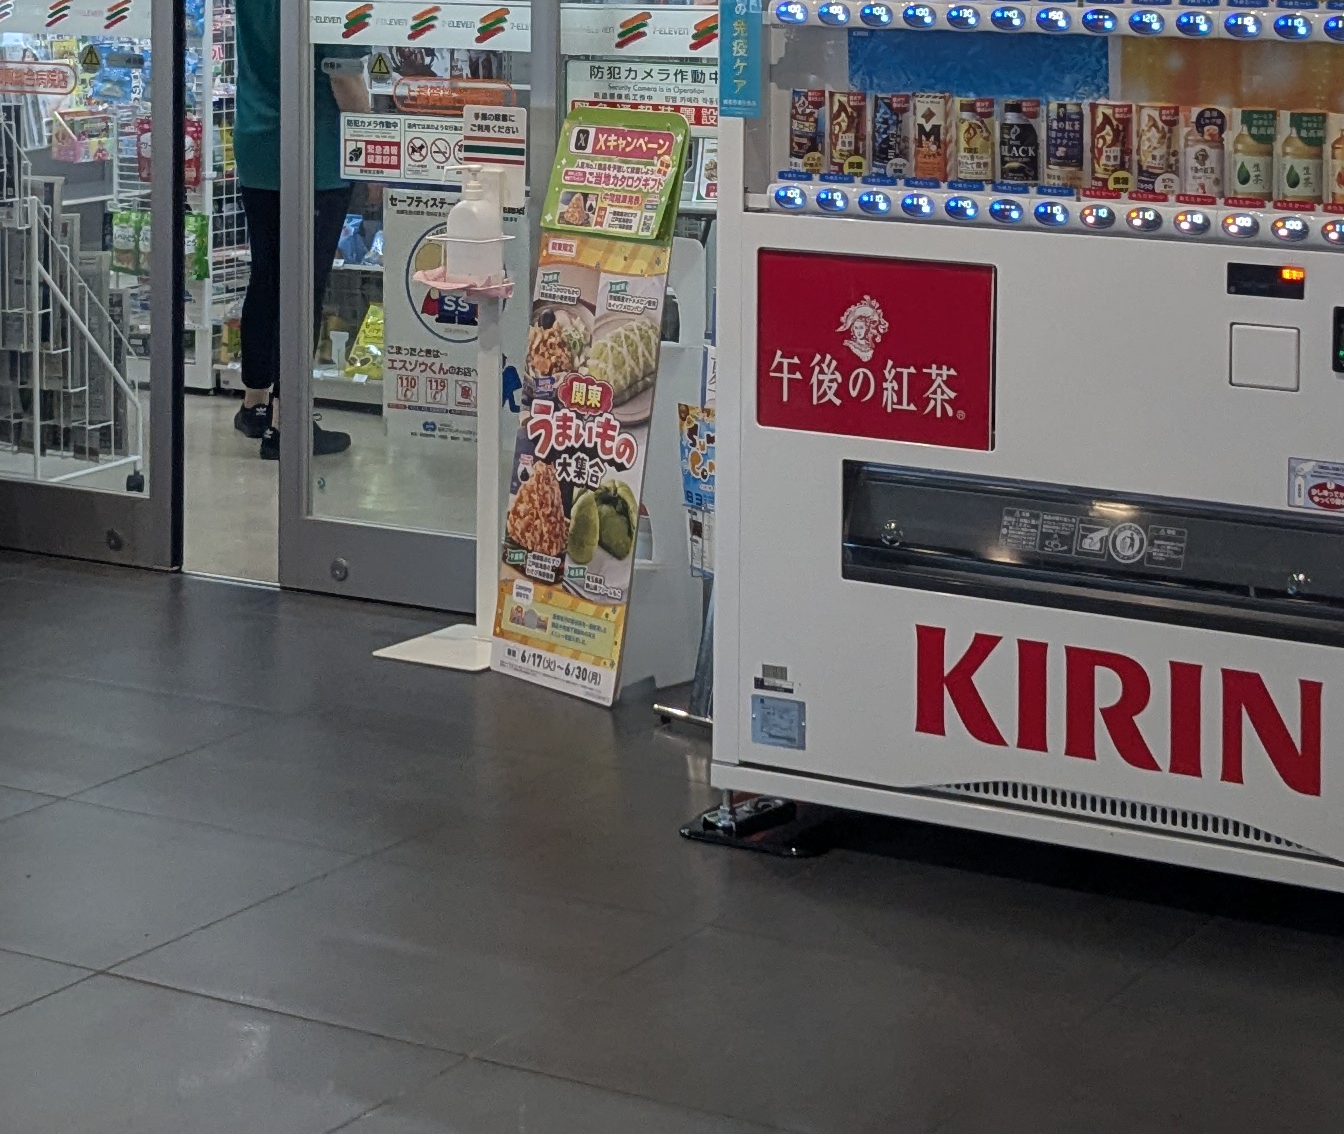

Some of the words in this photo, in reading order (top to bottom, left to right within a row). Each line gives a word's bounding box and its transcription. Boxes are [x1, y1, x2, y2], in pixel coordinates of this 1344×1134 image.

[469, 124, 520, 136] ご利用ください
[595, 132, 671, 155] Xキャンペーン
[585, 169, 665, 192] ご当地カタログギフト
[397, 376, 418, 390] 110
[427, 378, 448, 392] 119
[570, 381, 603, 408] 関東
[769, 349, 958, 419] 午後の紅茶
[527, 399, 638, 468] うまいもの
[556, 455, 607, 489] 大集合
[914, 623, 1323, 797] KIRIN
